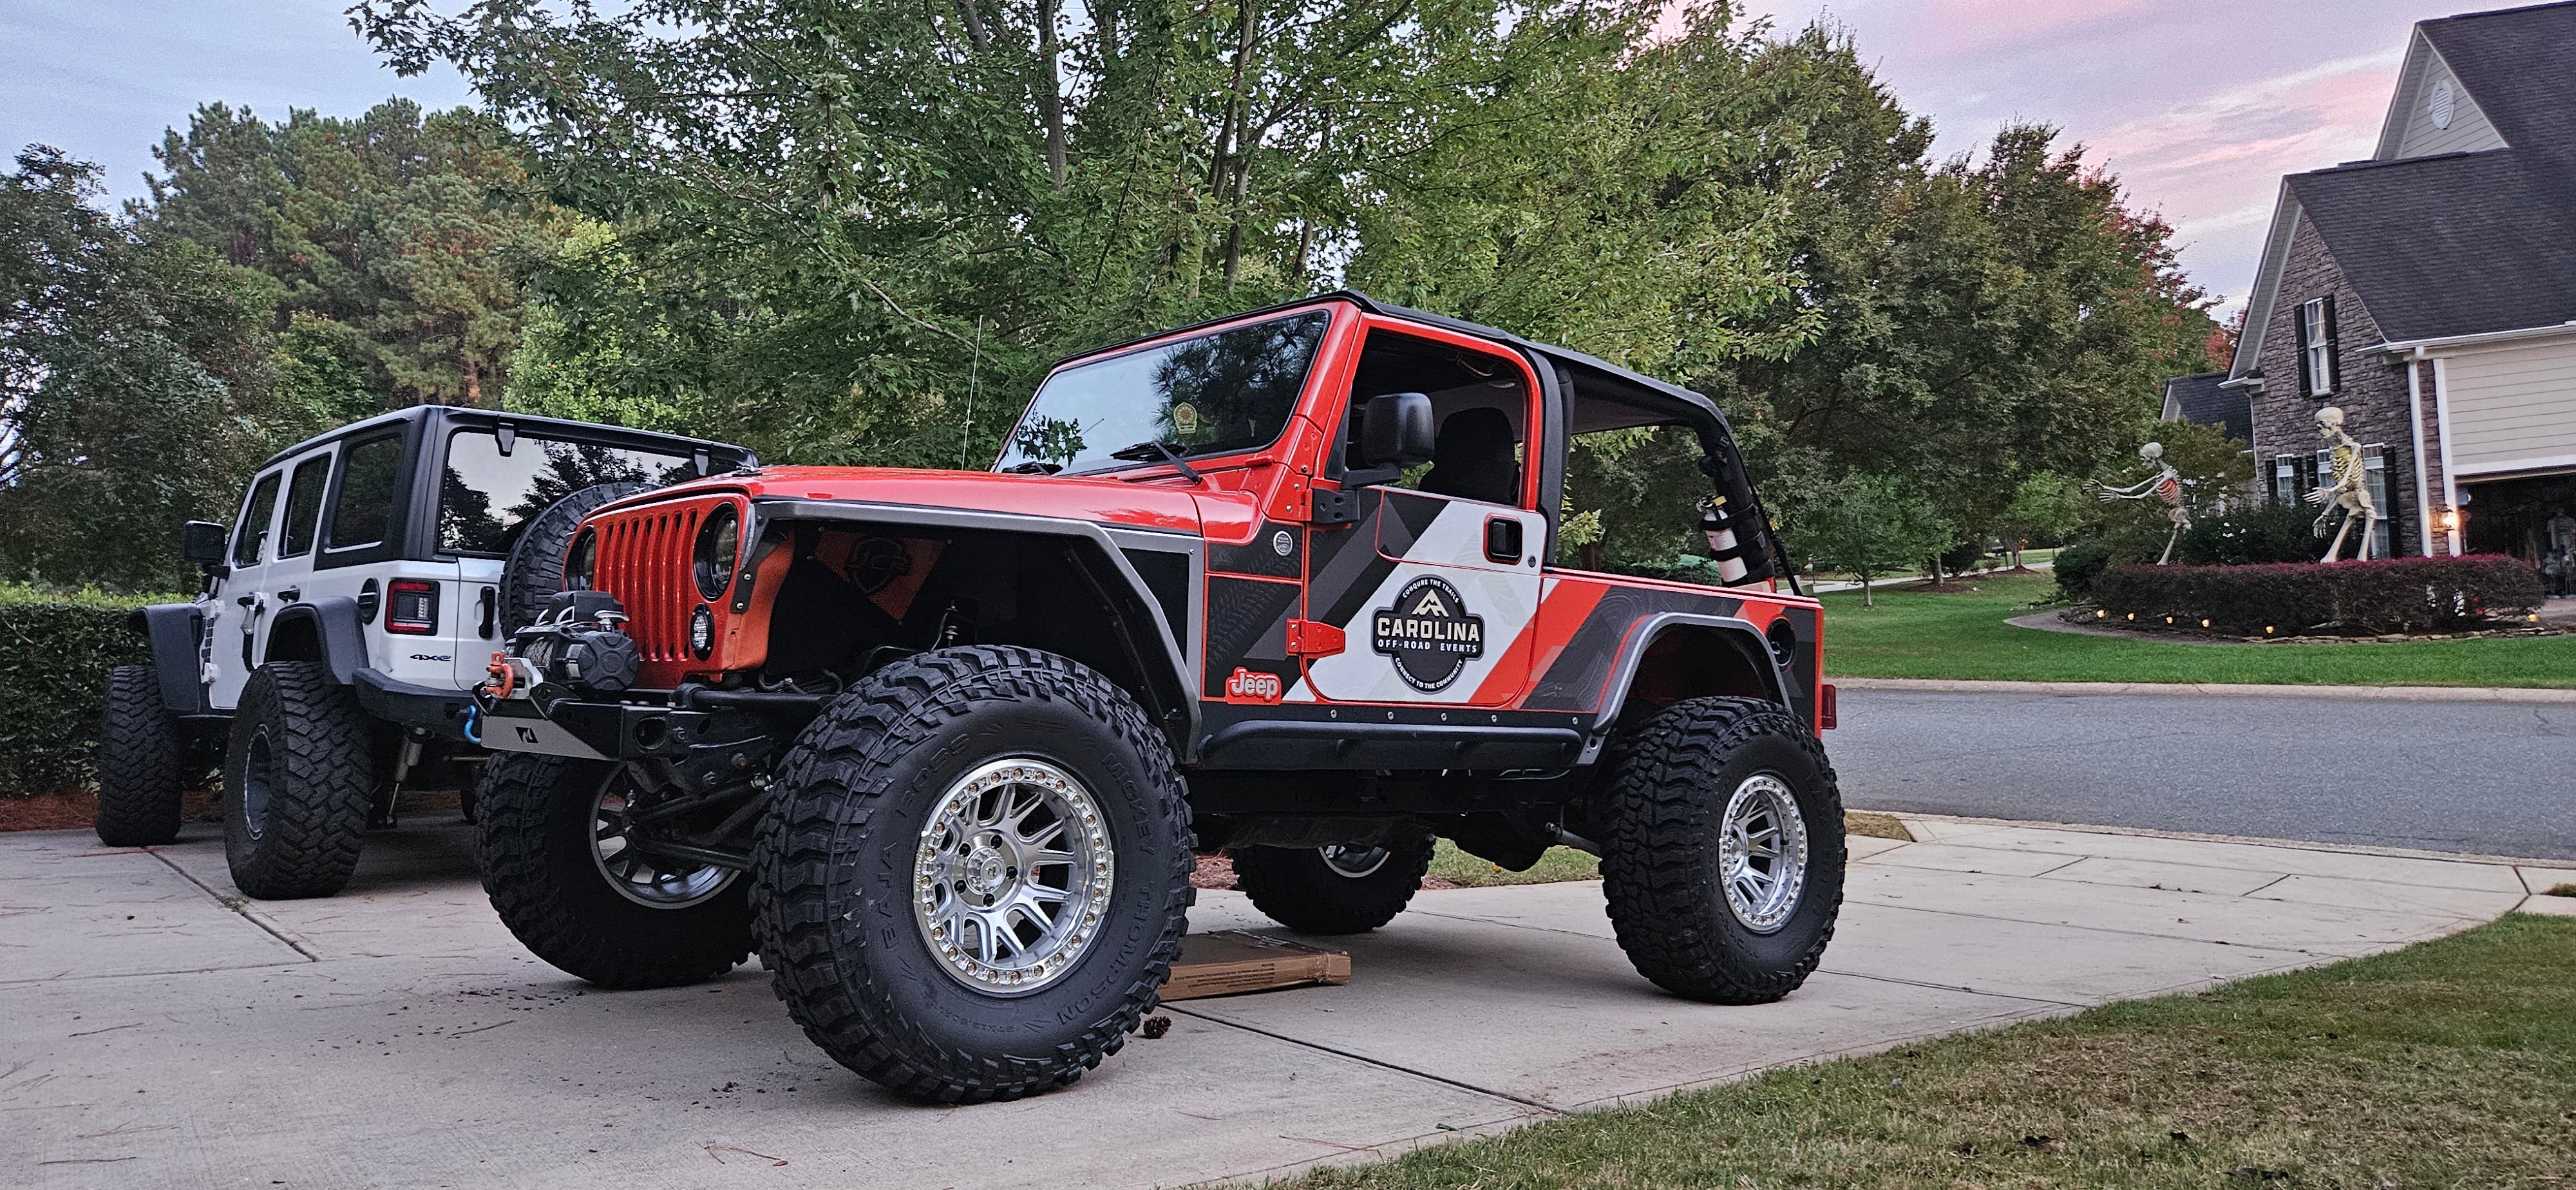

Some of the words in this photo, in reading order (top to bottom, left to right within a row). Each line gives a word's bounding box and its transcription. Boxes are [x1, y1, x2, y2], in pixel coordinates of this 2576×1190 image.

[1402, 579, 1428, 598] CONQURE
[1430, 579, 1441, 587] THE
[1442, 583, 1459, 603] TRAILS
[1378, 617, 1480, 642] CAROLINA
[1378, 639, 1431, 650] OFF-ROAD
[1440, 643, 1477, 653] EVENTS
[1229, 668, 1278, 701] Jeep
[1395, 657, 1416, 684] CONNECT
[1436, 659, 1463, 688] COMMUNITY
